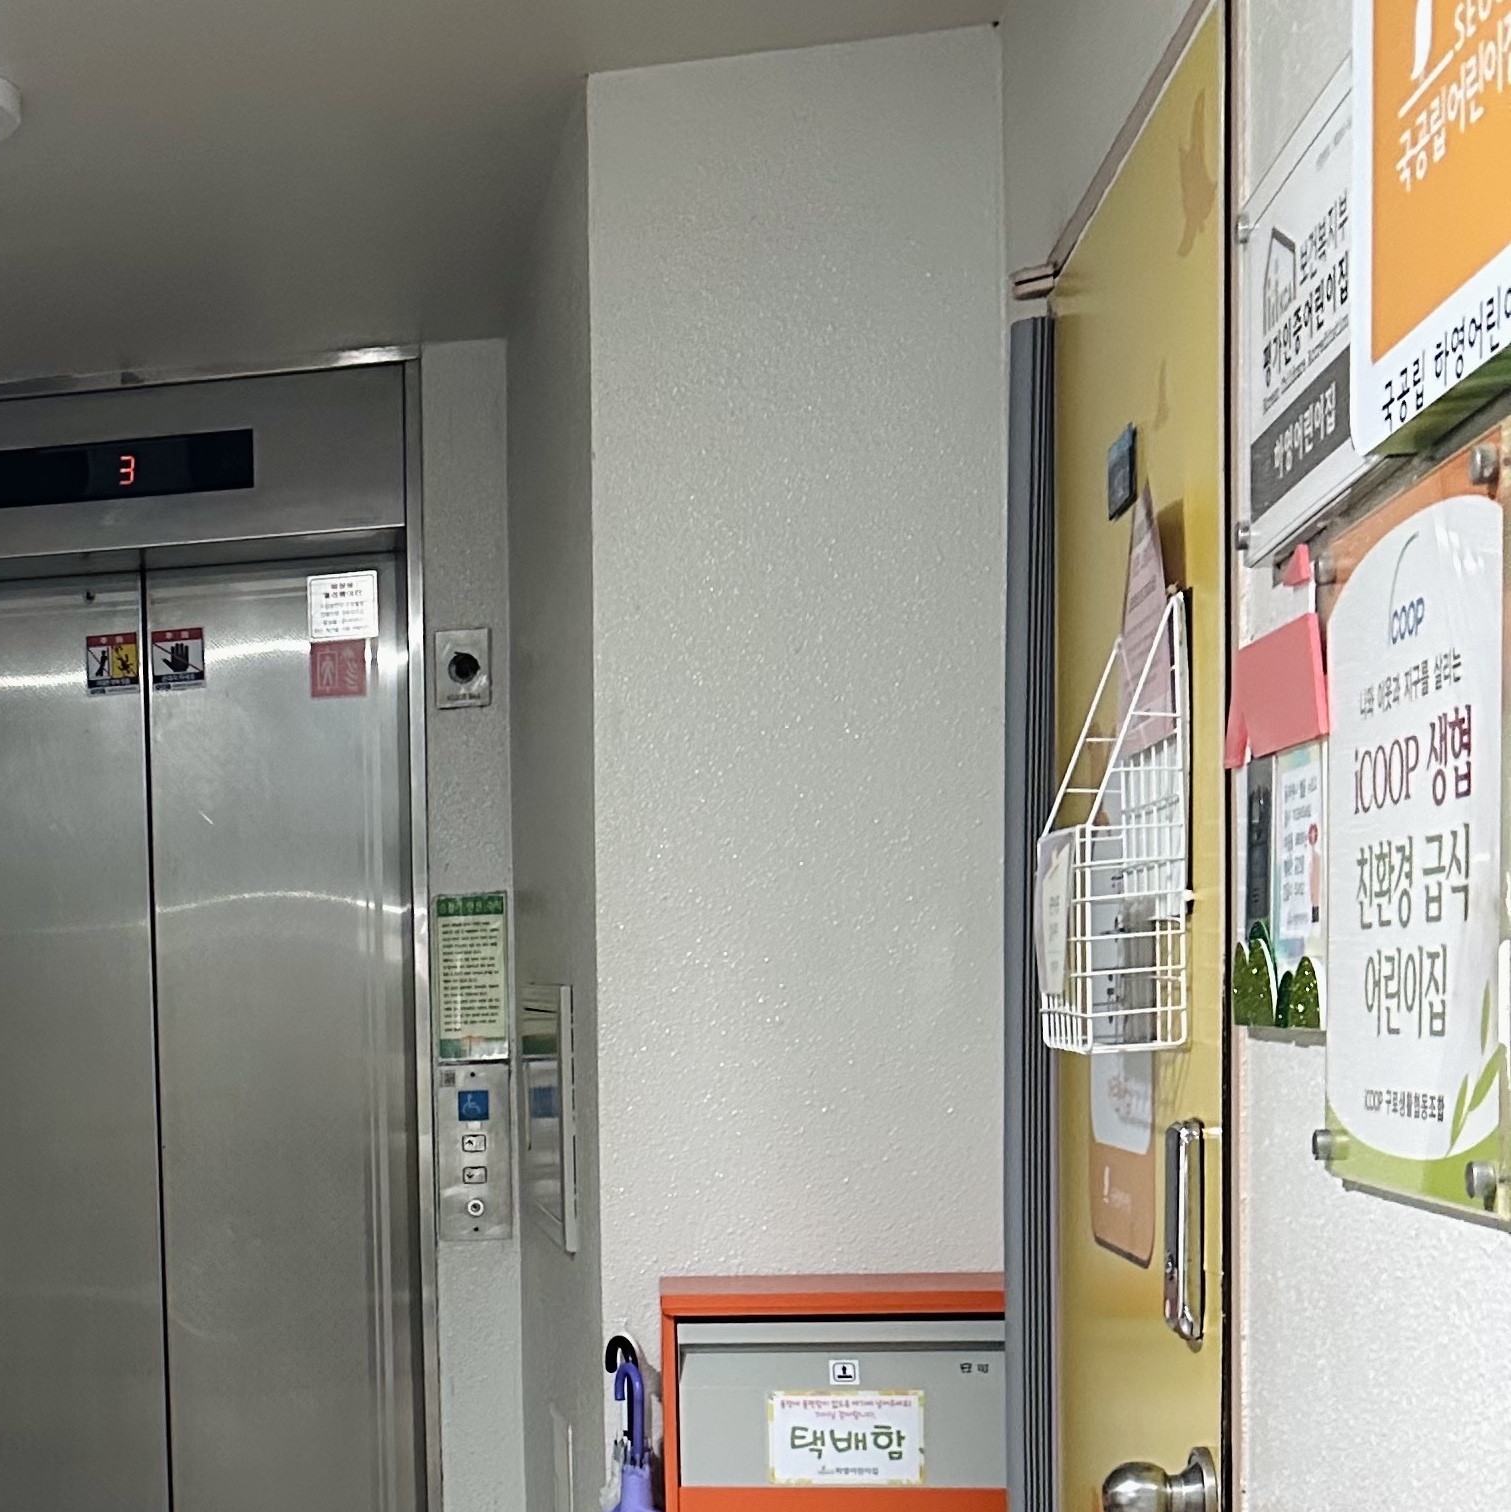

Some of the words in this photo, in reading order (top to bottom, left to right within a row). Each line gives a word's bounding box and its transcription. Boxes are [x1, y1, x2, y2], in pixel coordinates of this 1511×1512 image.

[1299, 188, 1348, 286] 보건복지부
[1263, 250, 1349, 387] 평가인증어린이집
[1381, 349, 1426, 433] 국공립
[119, 455, 136, 486] 3
[1404, 659, 1429, 702] 지구를
[1434, 647, 1462, 692] 살리는
[1354, 735, 1419, 815] iCOOP
[1426, 704, 1472, 806] 생협
[1356, 834, 1414, 931] 친환경
[1421, 822, 1471, 924] 급식
[1364, 943, 1448, 1039] 어린이집
[790, 1424, 906, 1461] 택배함
